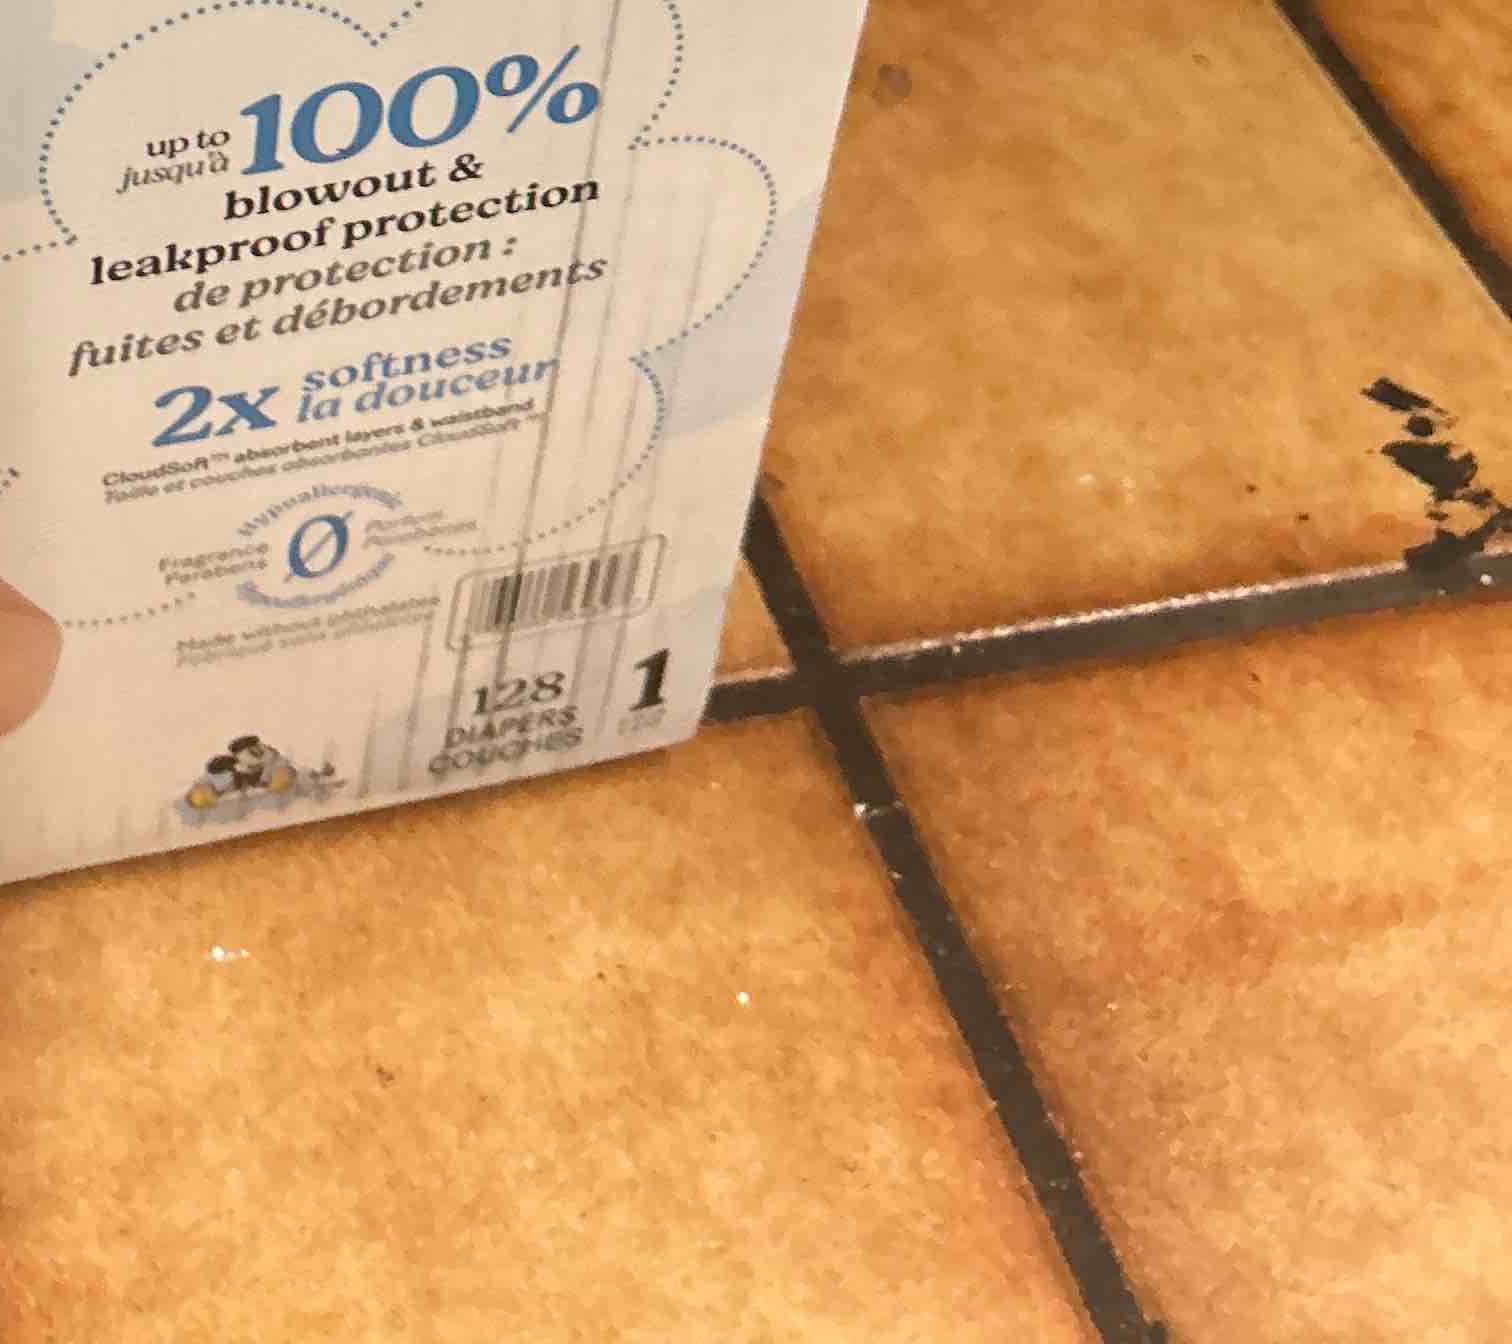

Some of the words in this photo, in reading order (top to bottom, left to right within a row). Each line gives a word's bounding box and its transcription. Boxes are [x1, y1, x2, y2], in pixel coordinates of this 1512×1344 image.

[239, 45, 601, 176] 100%
[117, 152, 230, 193] jusqu'à
[145, 133, 189, 161] up
[195, 127, 231, 150] to
[224, 161, 437, 221] blowout
[448, 152, 484, 181] &
[90, 217, 333, 285] leakproof
[343, 178, 601, 248] protection
[173, 279, 230, 313] de
[239, 236, 491, 311] protection
[68, 328, 204, 377] fuites
[215, 317, 260, 348] et
[272, 254, 607, 338] débordements
[297, 389, 342, 424] la
[354, 358, 560, 414] douceur
[302, 336, 514, 394] softness
[152, 384, 280, 448] 2x
[233, 433, 340, 464] absorbent
[345, 423, 406, 446] layers
[410, 416, 425, 432] &
[473, 670, 566, 715] 128
[629, 648, 670, 712] 1
[428, 726, 584, 775] COUCHES
[444, 705, 579, 749] DIAPERS
